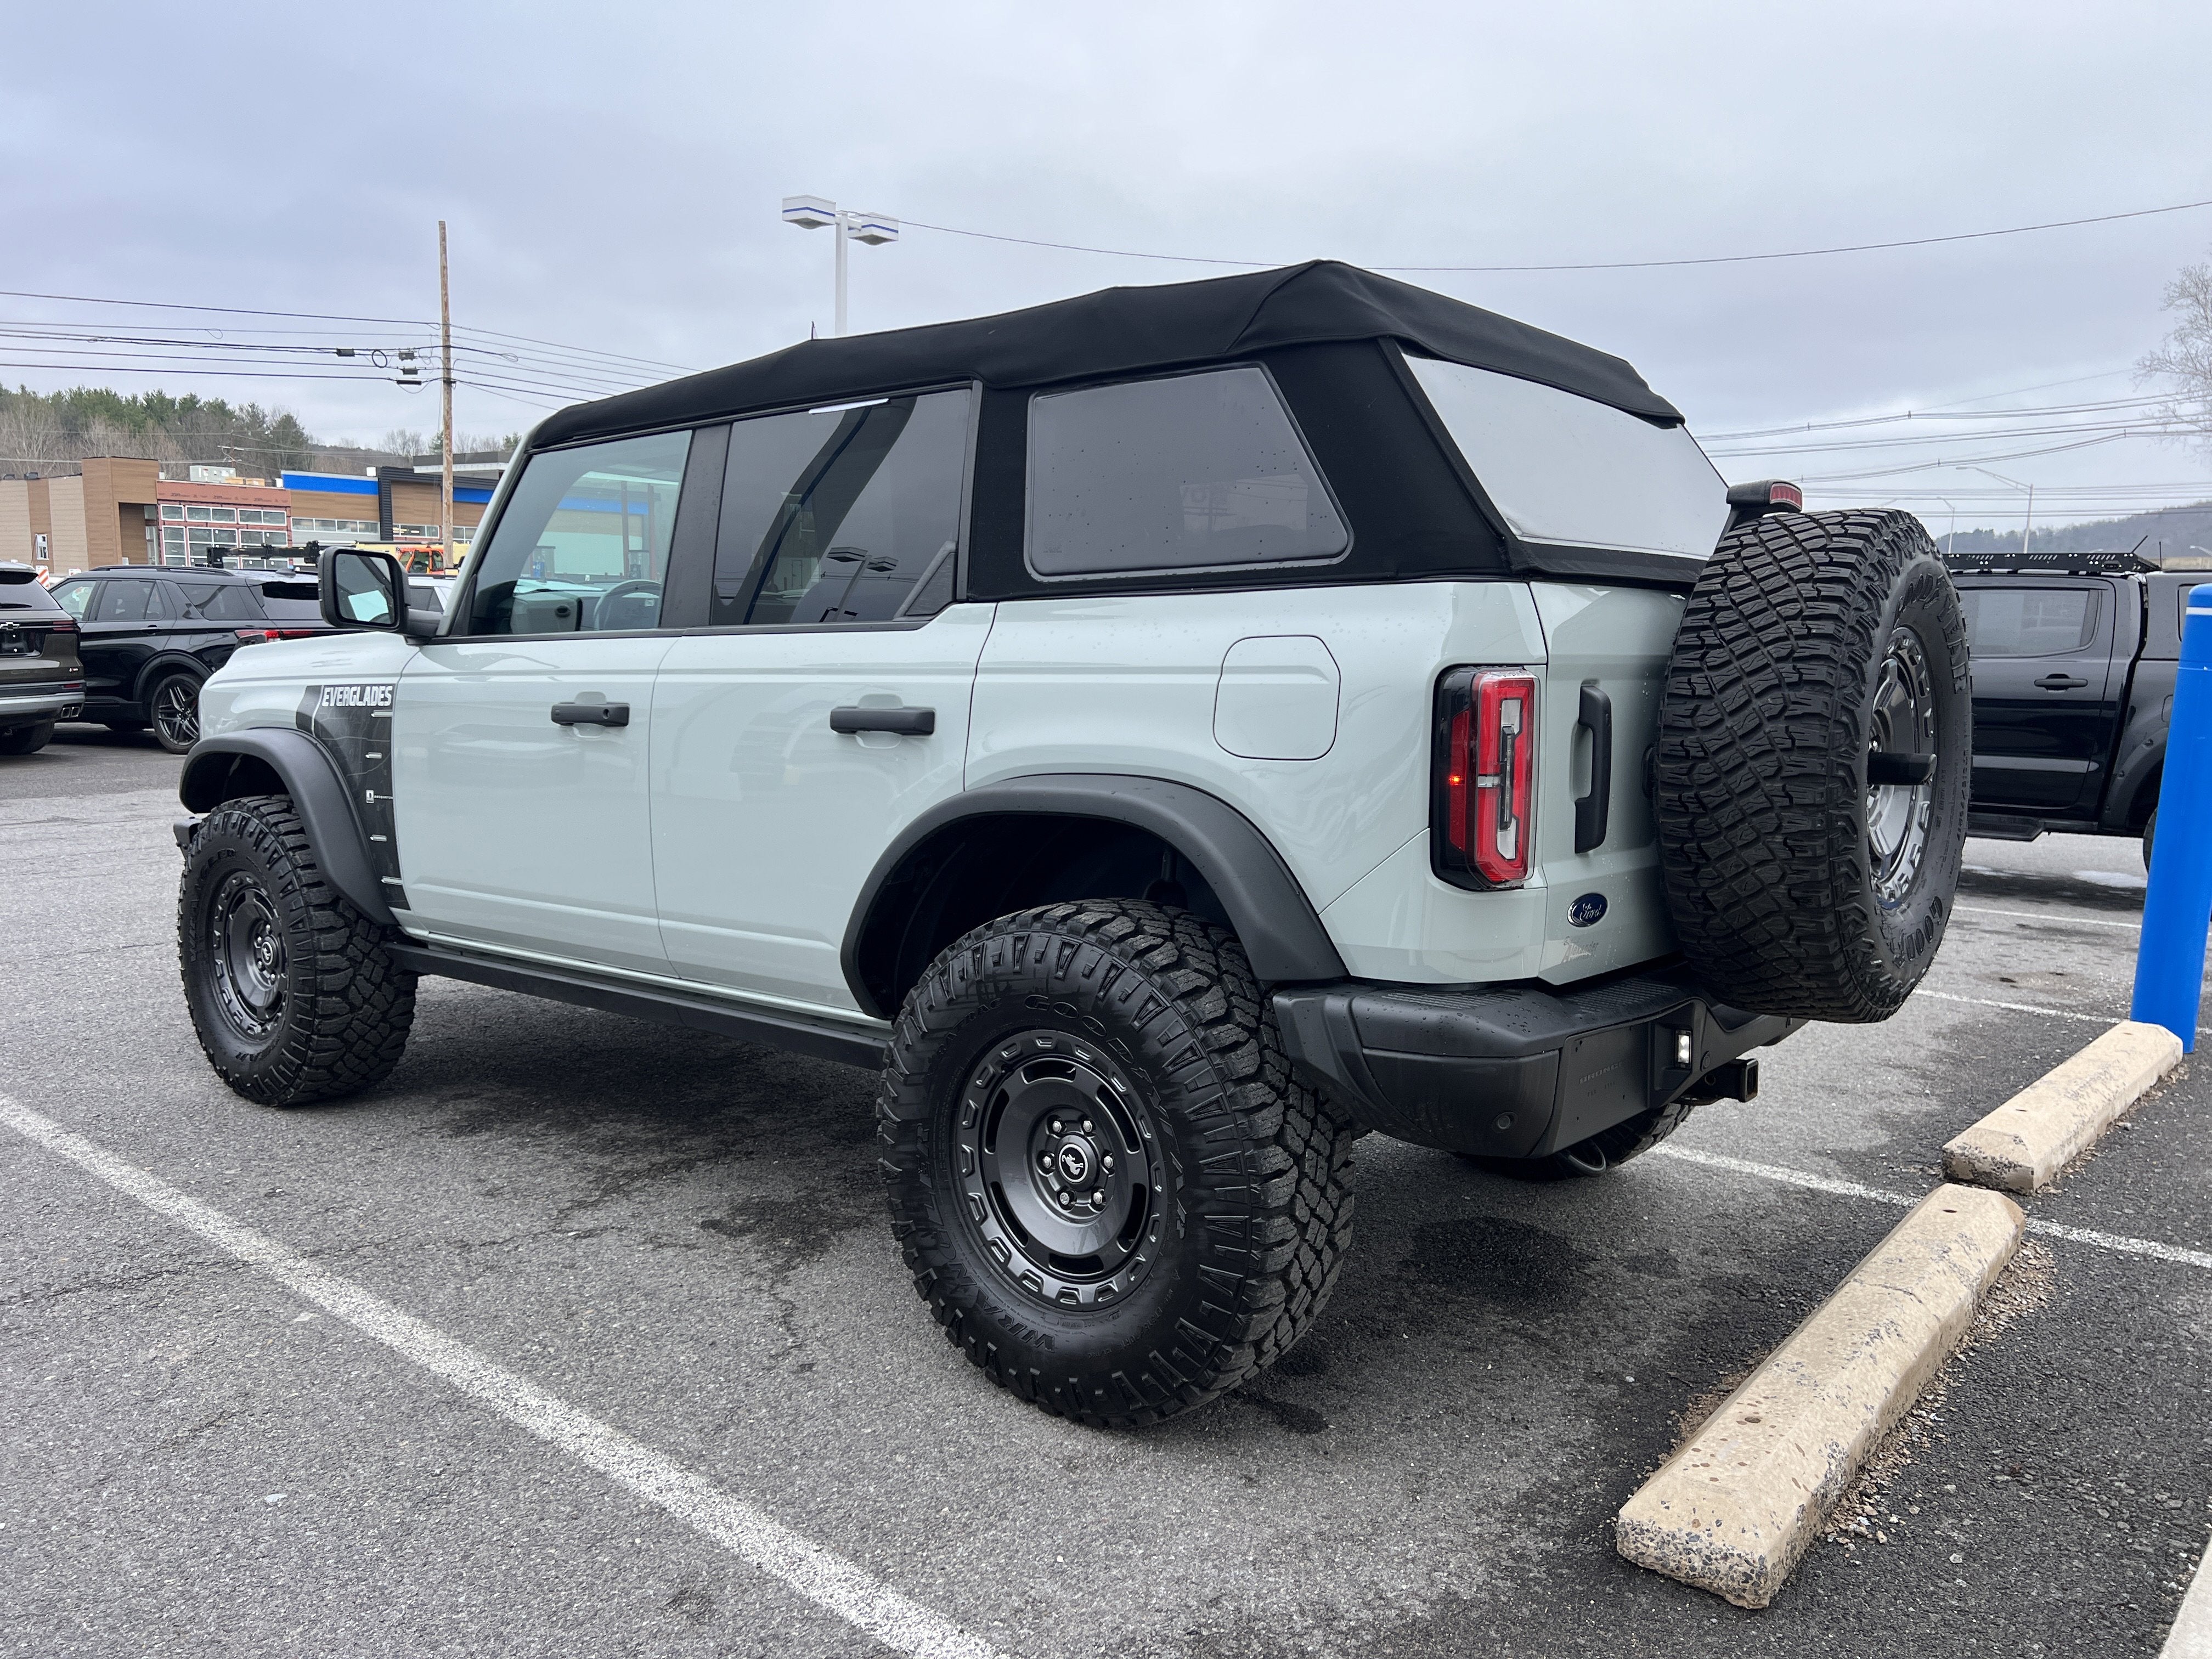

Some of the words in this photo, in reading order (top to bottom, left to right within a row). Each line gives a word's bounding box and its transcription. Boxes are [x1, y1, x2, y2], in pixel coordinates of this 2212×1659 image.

[321, 686, 393, 707] EVERGLADES
[1579, 902, 1602, 921] Ford
[1024, 994, 1187, 1239] GOODYEAR
[916, 1122, 1056, 1353] WRANGLER
